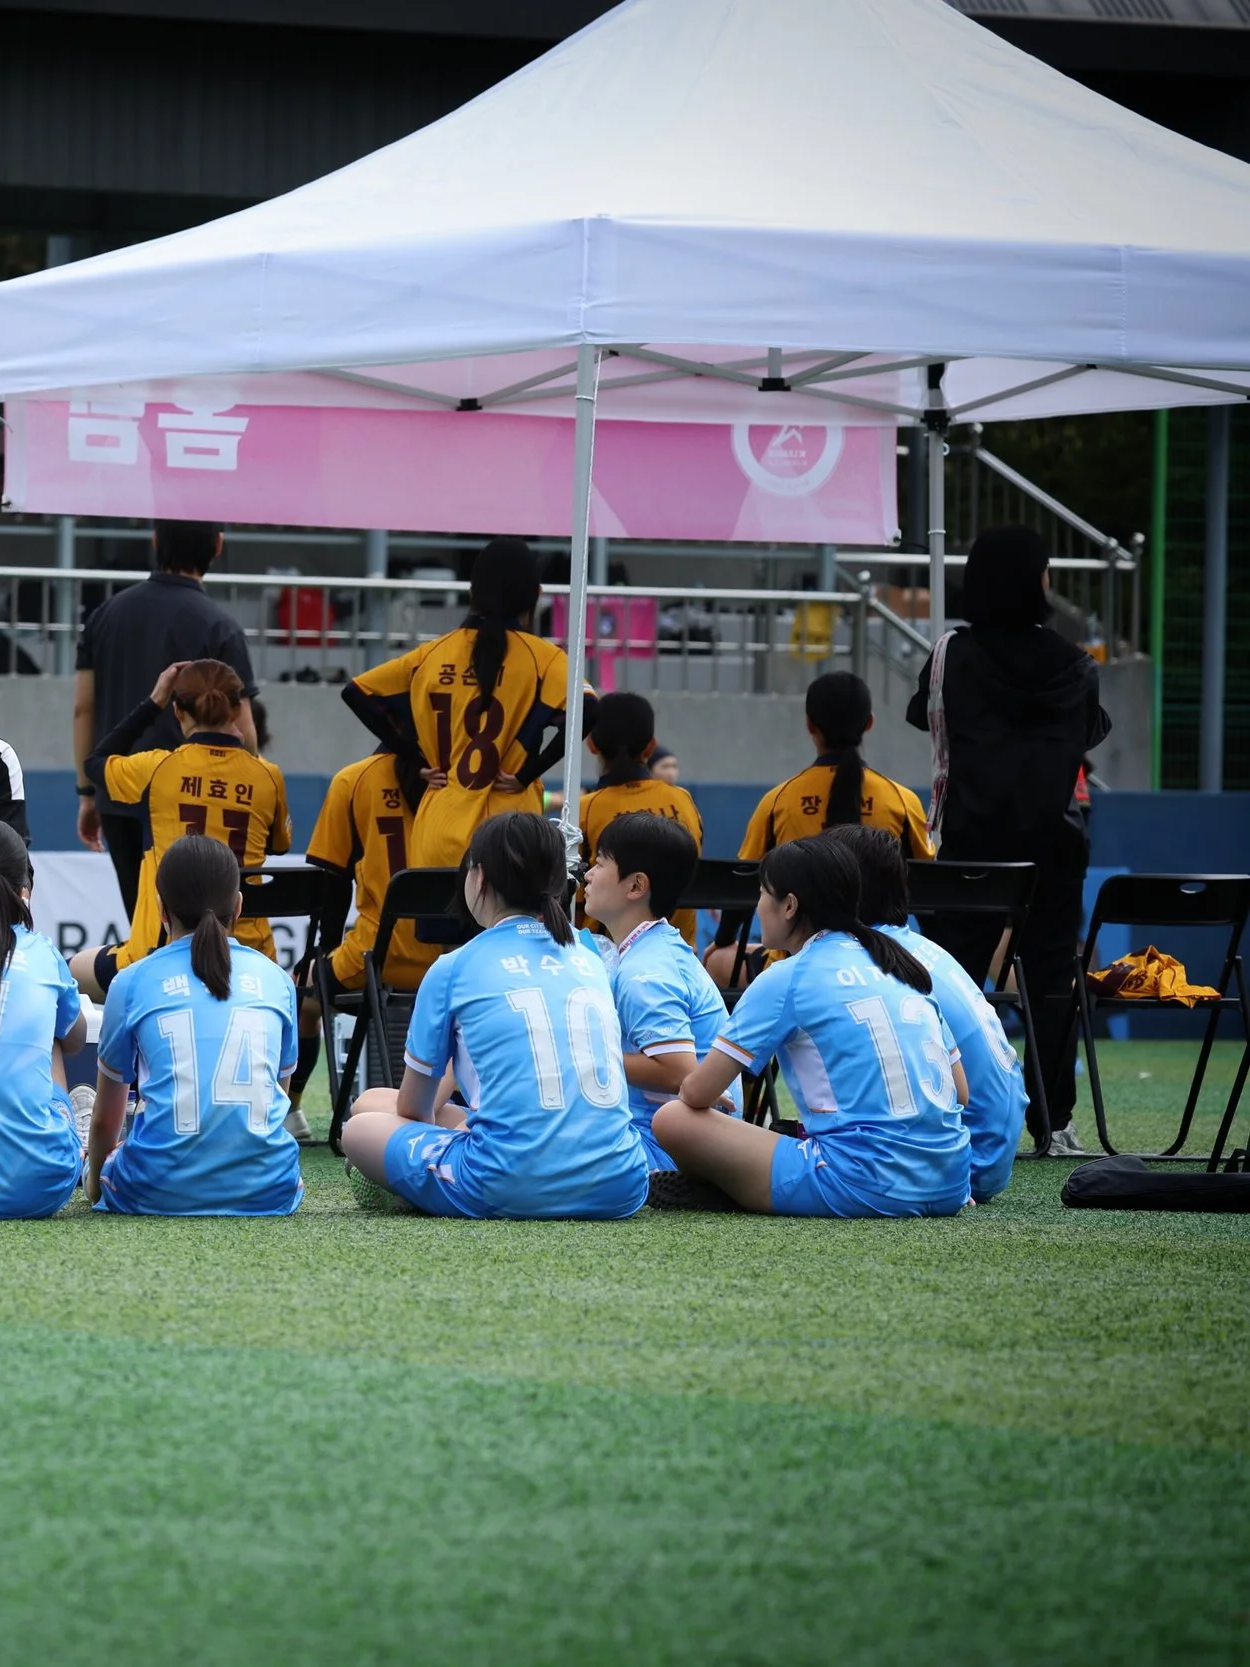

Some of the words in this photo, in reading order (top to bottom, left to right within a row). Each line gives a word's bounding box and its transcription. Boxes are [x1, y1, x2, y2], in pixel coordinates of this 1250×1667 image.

[438, 663, 506, 687] 공손
[428, 691, 505, 791] 18
[180, 776, 254, 806] 제효인
[800, 795, 875, 816] 장선
[501, 954, 597, 978] 박수연
[161, 973, 264, 1001] 백희
[505, 986, 623, 1111] 10
[845, 995, 958, 1117] 13
[157, 1007, 275, 1135] 14
